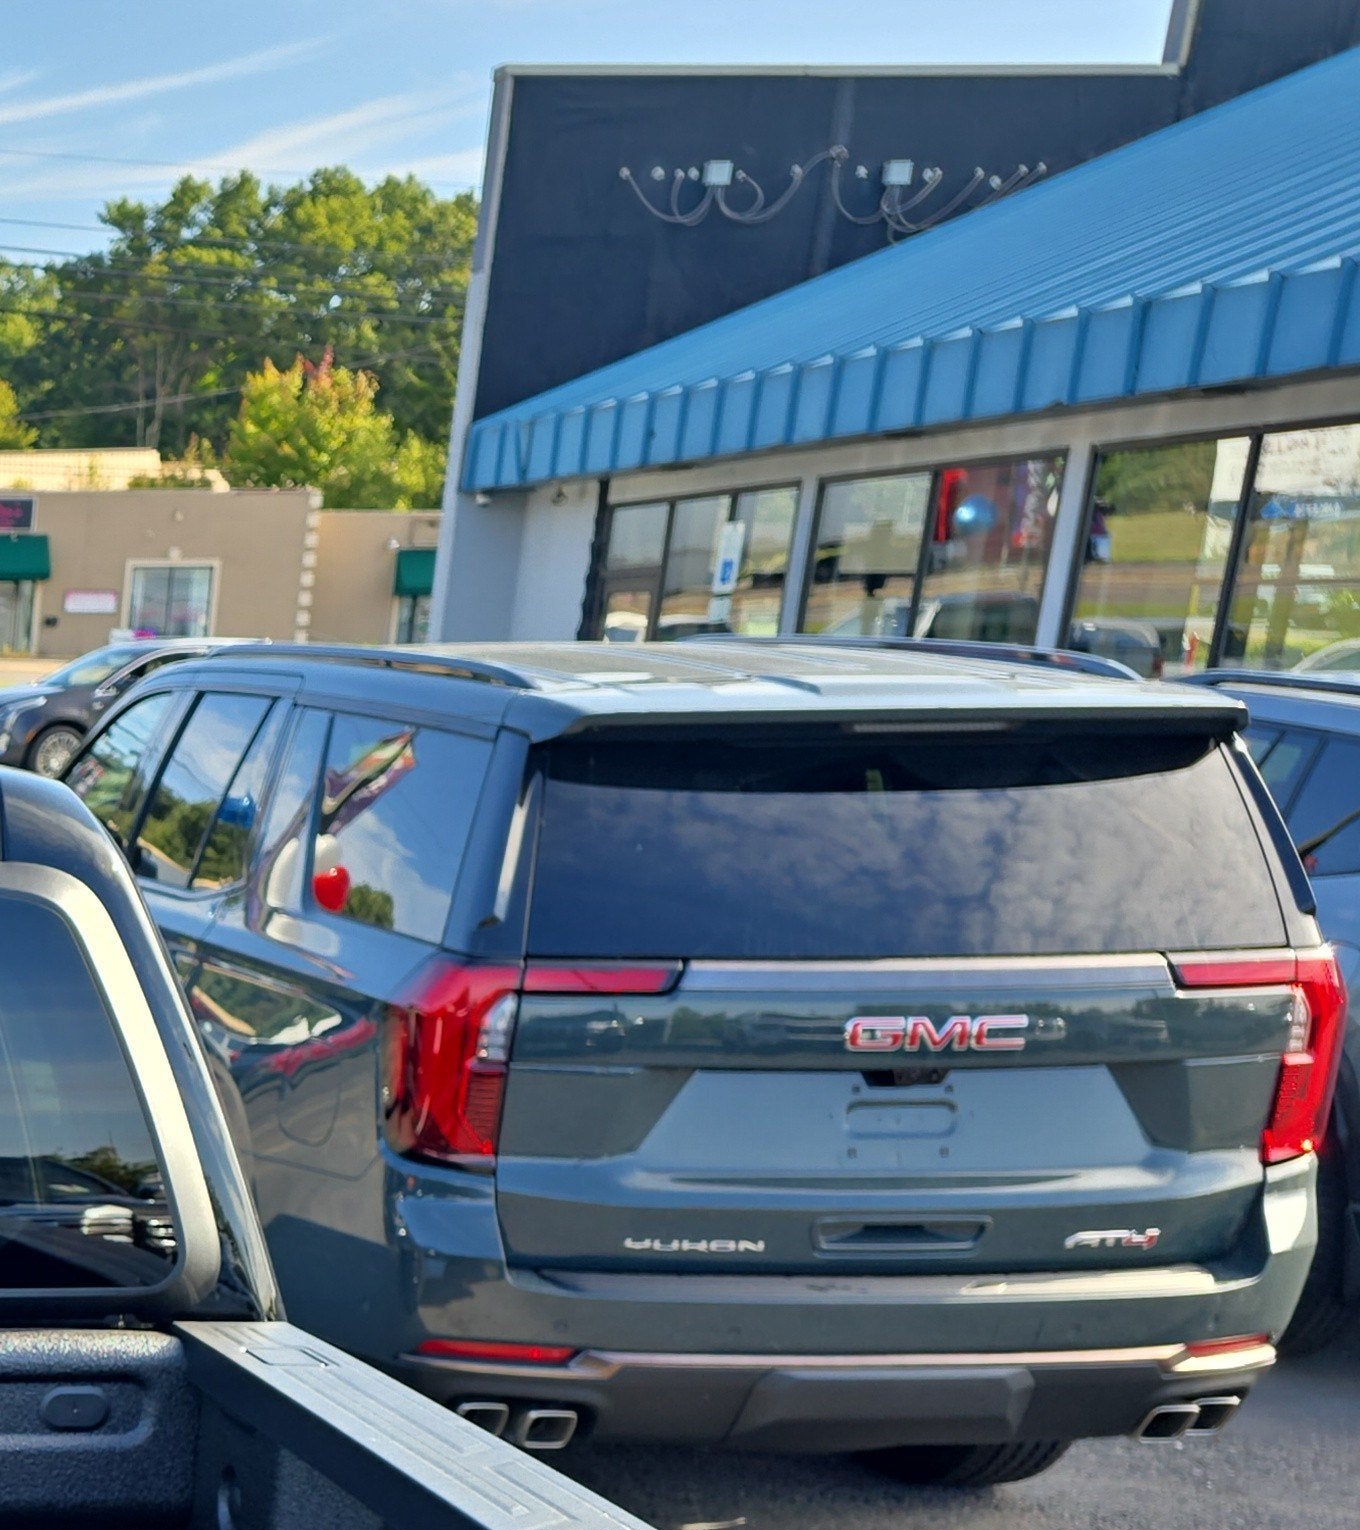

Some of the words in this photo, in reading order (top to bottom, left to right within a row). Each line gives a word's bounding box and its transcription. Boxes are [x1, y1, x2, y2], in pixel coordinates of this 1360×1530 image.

[843, 1014, 1029, 1052] GMC
[623, 1237, 766, 1252] YUKON
[1064, 1228, 1161, 1250] AT4
